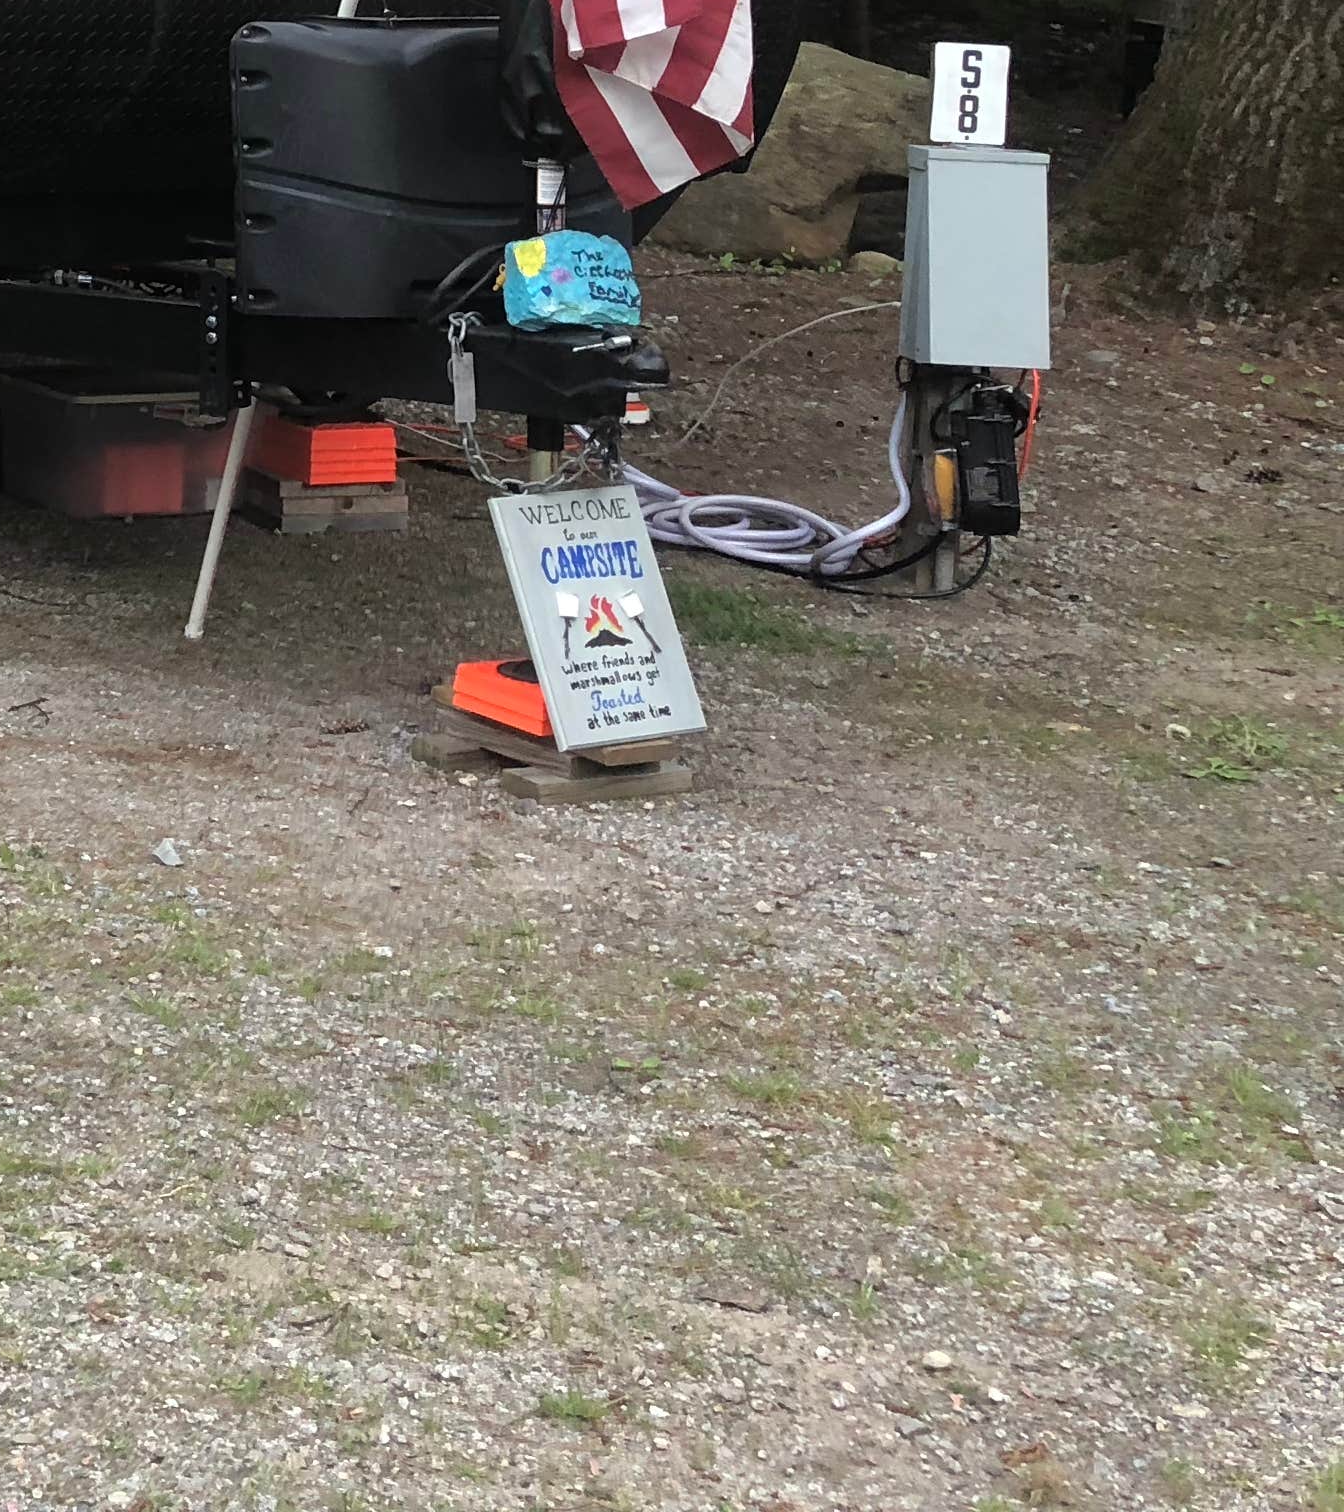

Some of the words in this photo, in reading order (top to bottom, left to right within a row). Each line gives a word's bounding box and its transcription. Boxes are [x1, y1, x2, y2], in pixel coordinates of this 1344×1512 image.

[571, 249, 603, 262] The
[519, 498, 631, 524] WELCOME
[563, 528, 575, 541] to
[580, 531, 598, 540] our
[541, 540, 643, 584] CAMPSITE
[561, 660, 599, 675] where
[602, 652, 634, 668] friends
[638, 651, 656, 665] and
[570, 671, 642, 690] marshmallows
[646, 667, 660, 686] get
[591, 686, 645, 711] Toasted
[587, 713, 601, 729] at
[603, 710, 620, 726] the
[623, 710, 645, 722] same
[648, 704, 671, 718] time
